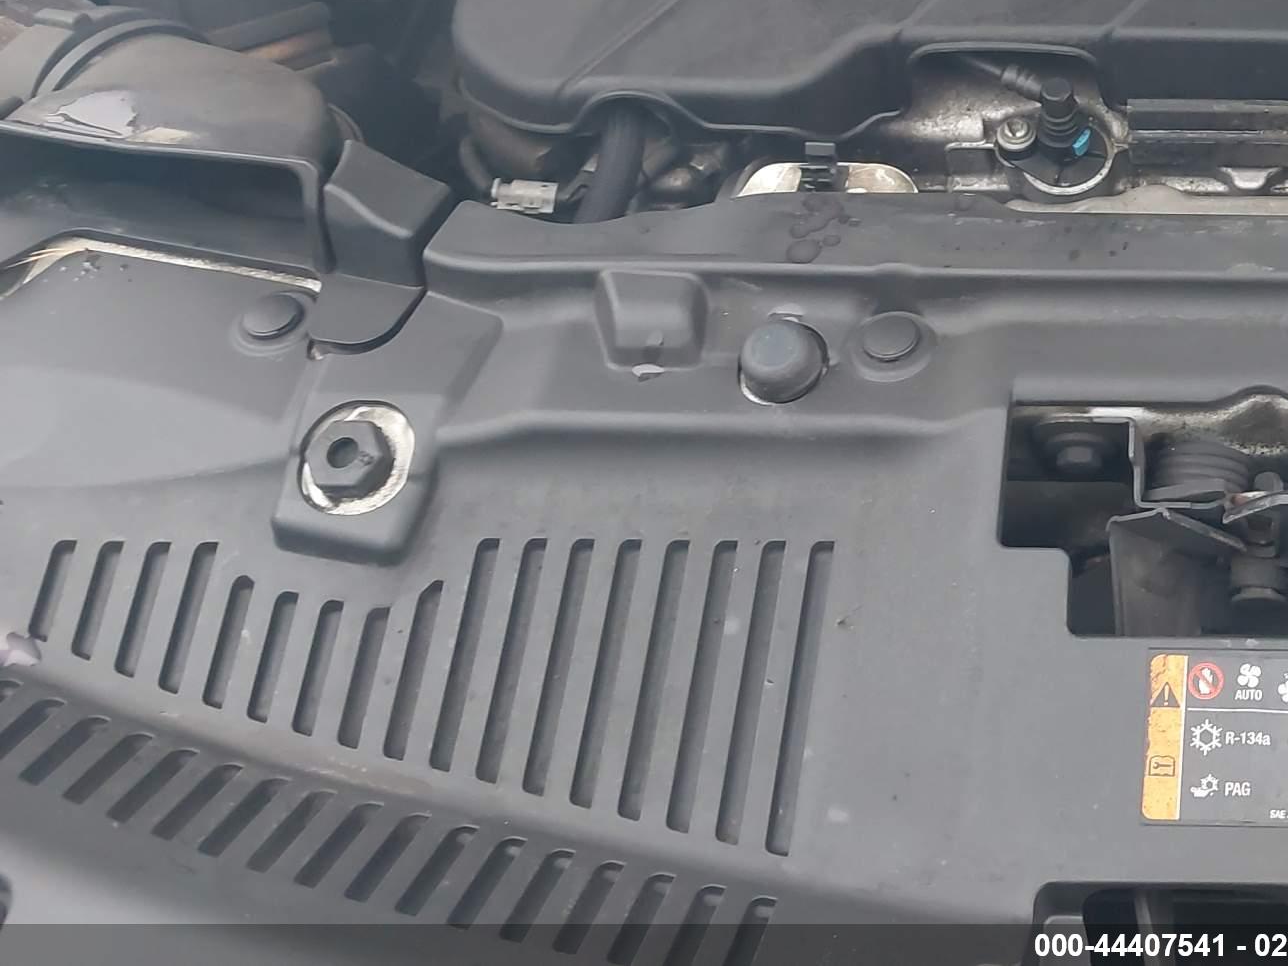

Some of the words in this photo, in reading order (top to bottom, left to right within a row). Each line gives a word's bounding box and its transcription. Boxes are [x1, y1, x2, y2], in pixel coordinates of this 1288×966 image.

[1234, 688, 1264, 701] AUTO
[1225, 731, 1271, 747] R-134a
[1224, 781, 1251, 797] PAG
[1269, 809, 1287, 819] SAE
